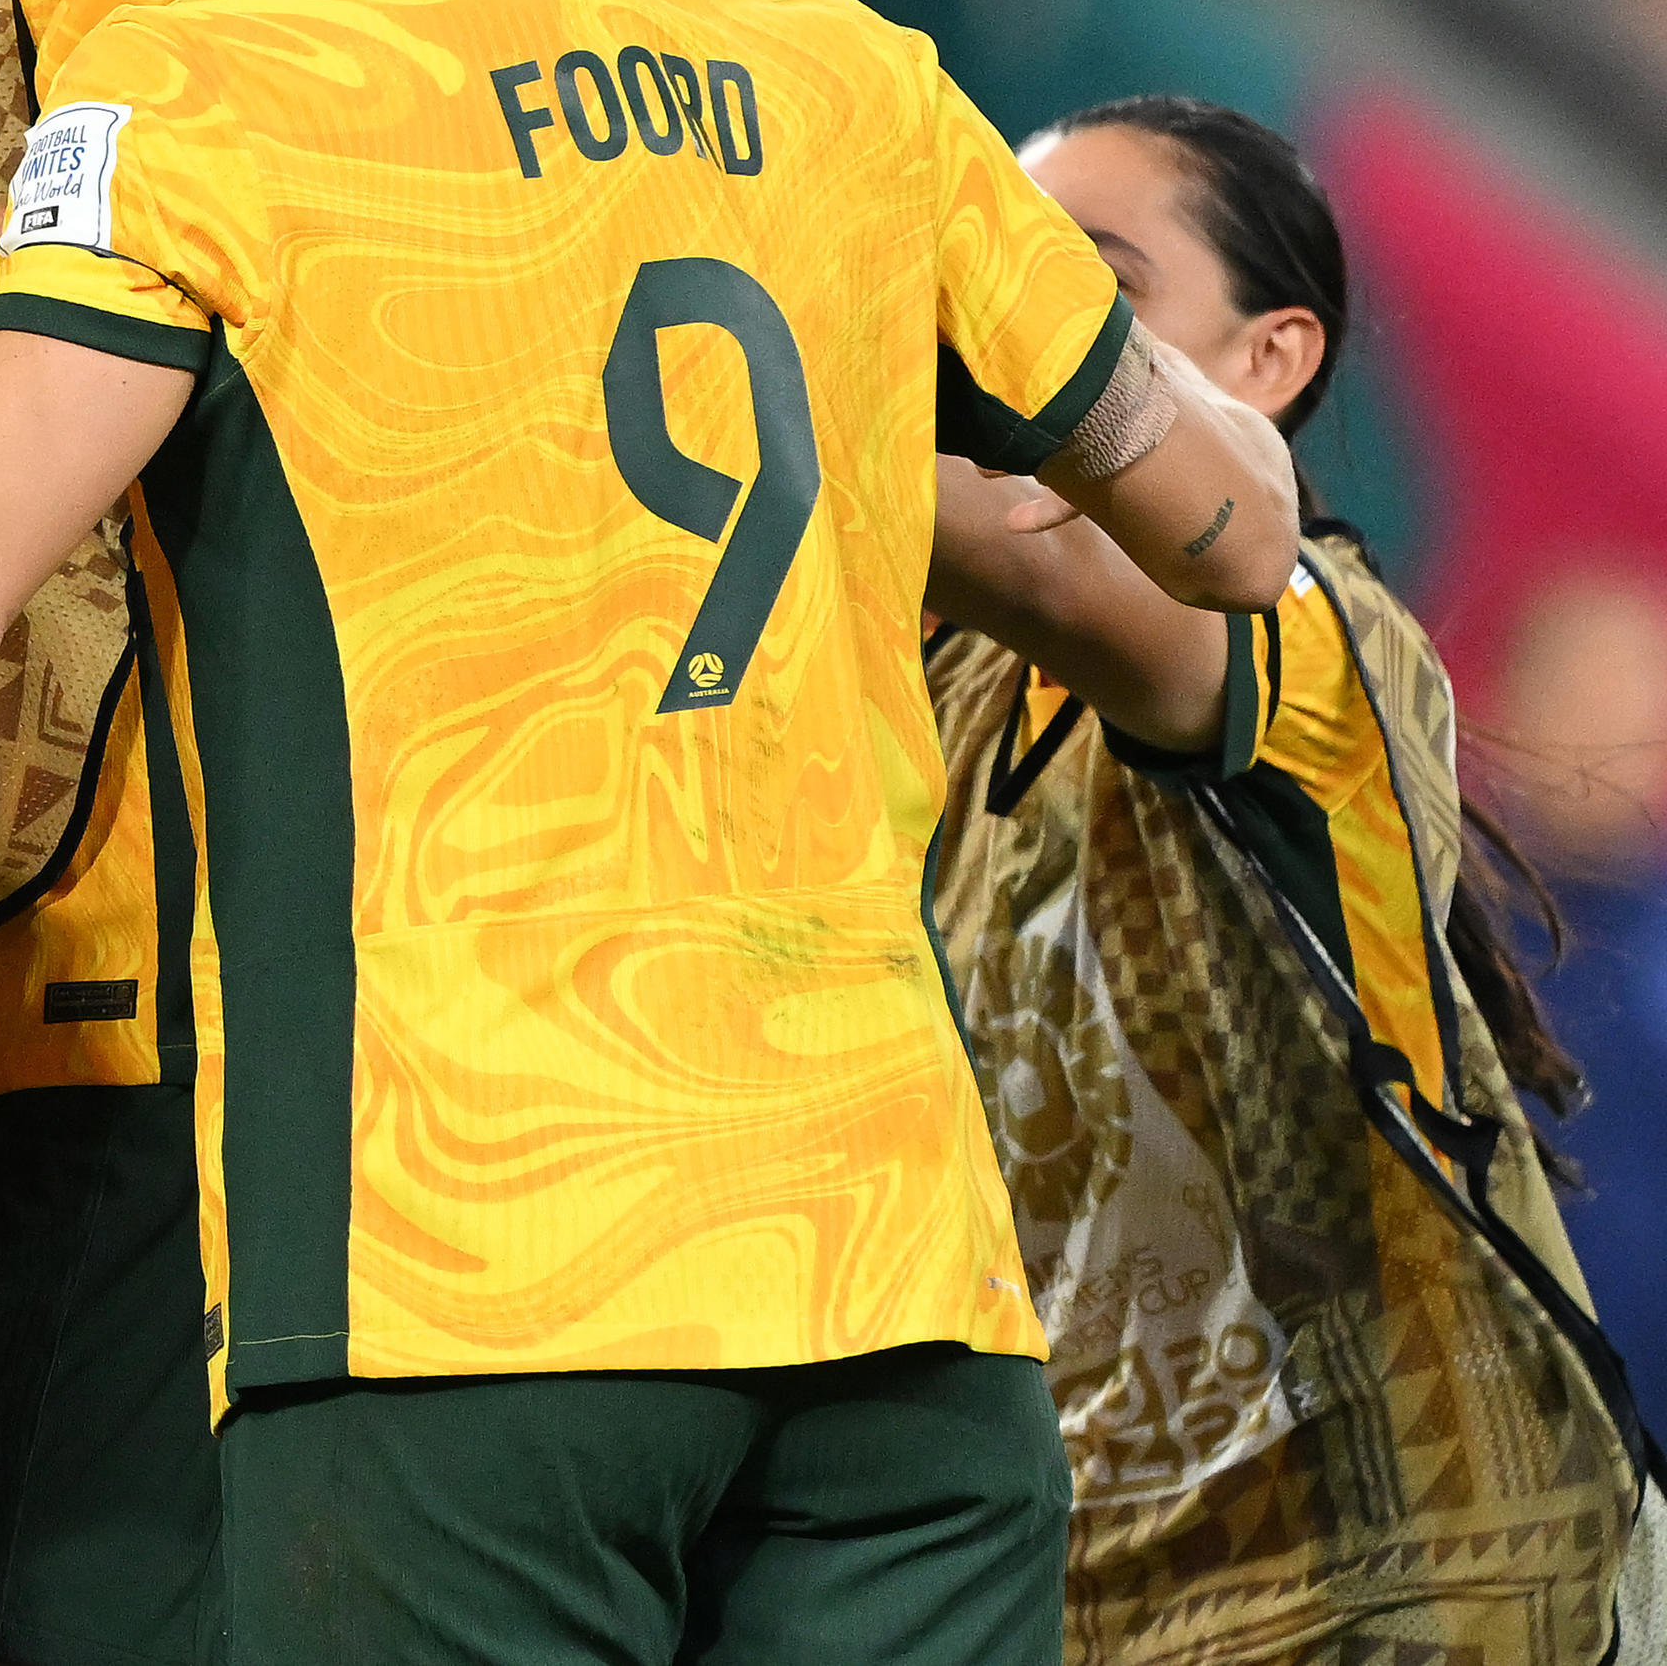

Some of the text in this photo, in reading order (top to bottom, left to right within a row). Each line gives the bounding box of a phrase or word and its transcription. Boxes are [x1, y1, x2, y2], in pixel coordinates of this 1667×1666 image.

[490, 45, 764, 179] FOORD
[27, 125, 87, 160] FOOTBALL
[21, 146, 85, 185] UNITES
[33, 173, 85, 204] World
[603, 257, 822, 715] 9
